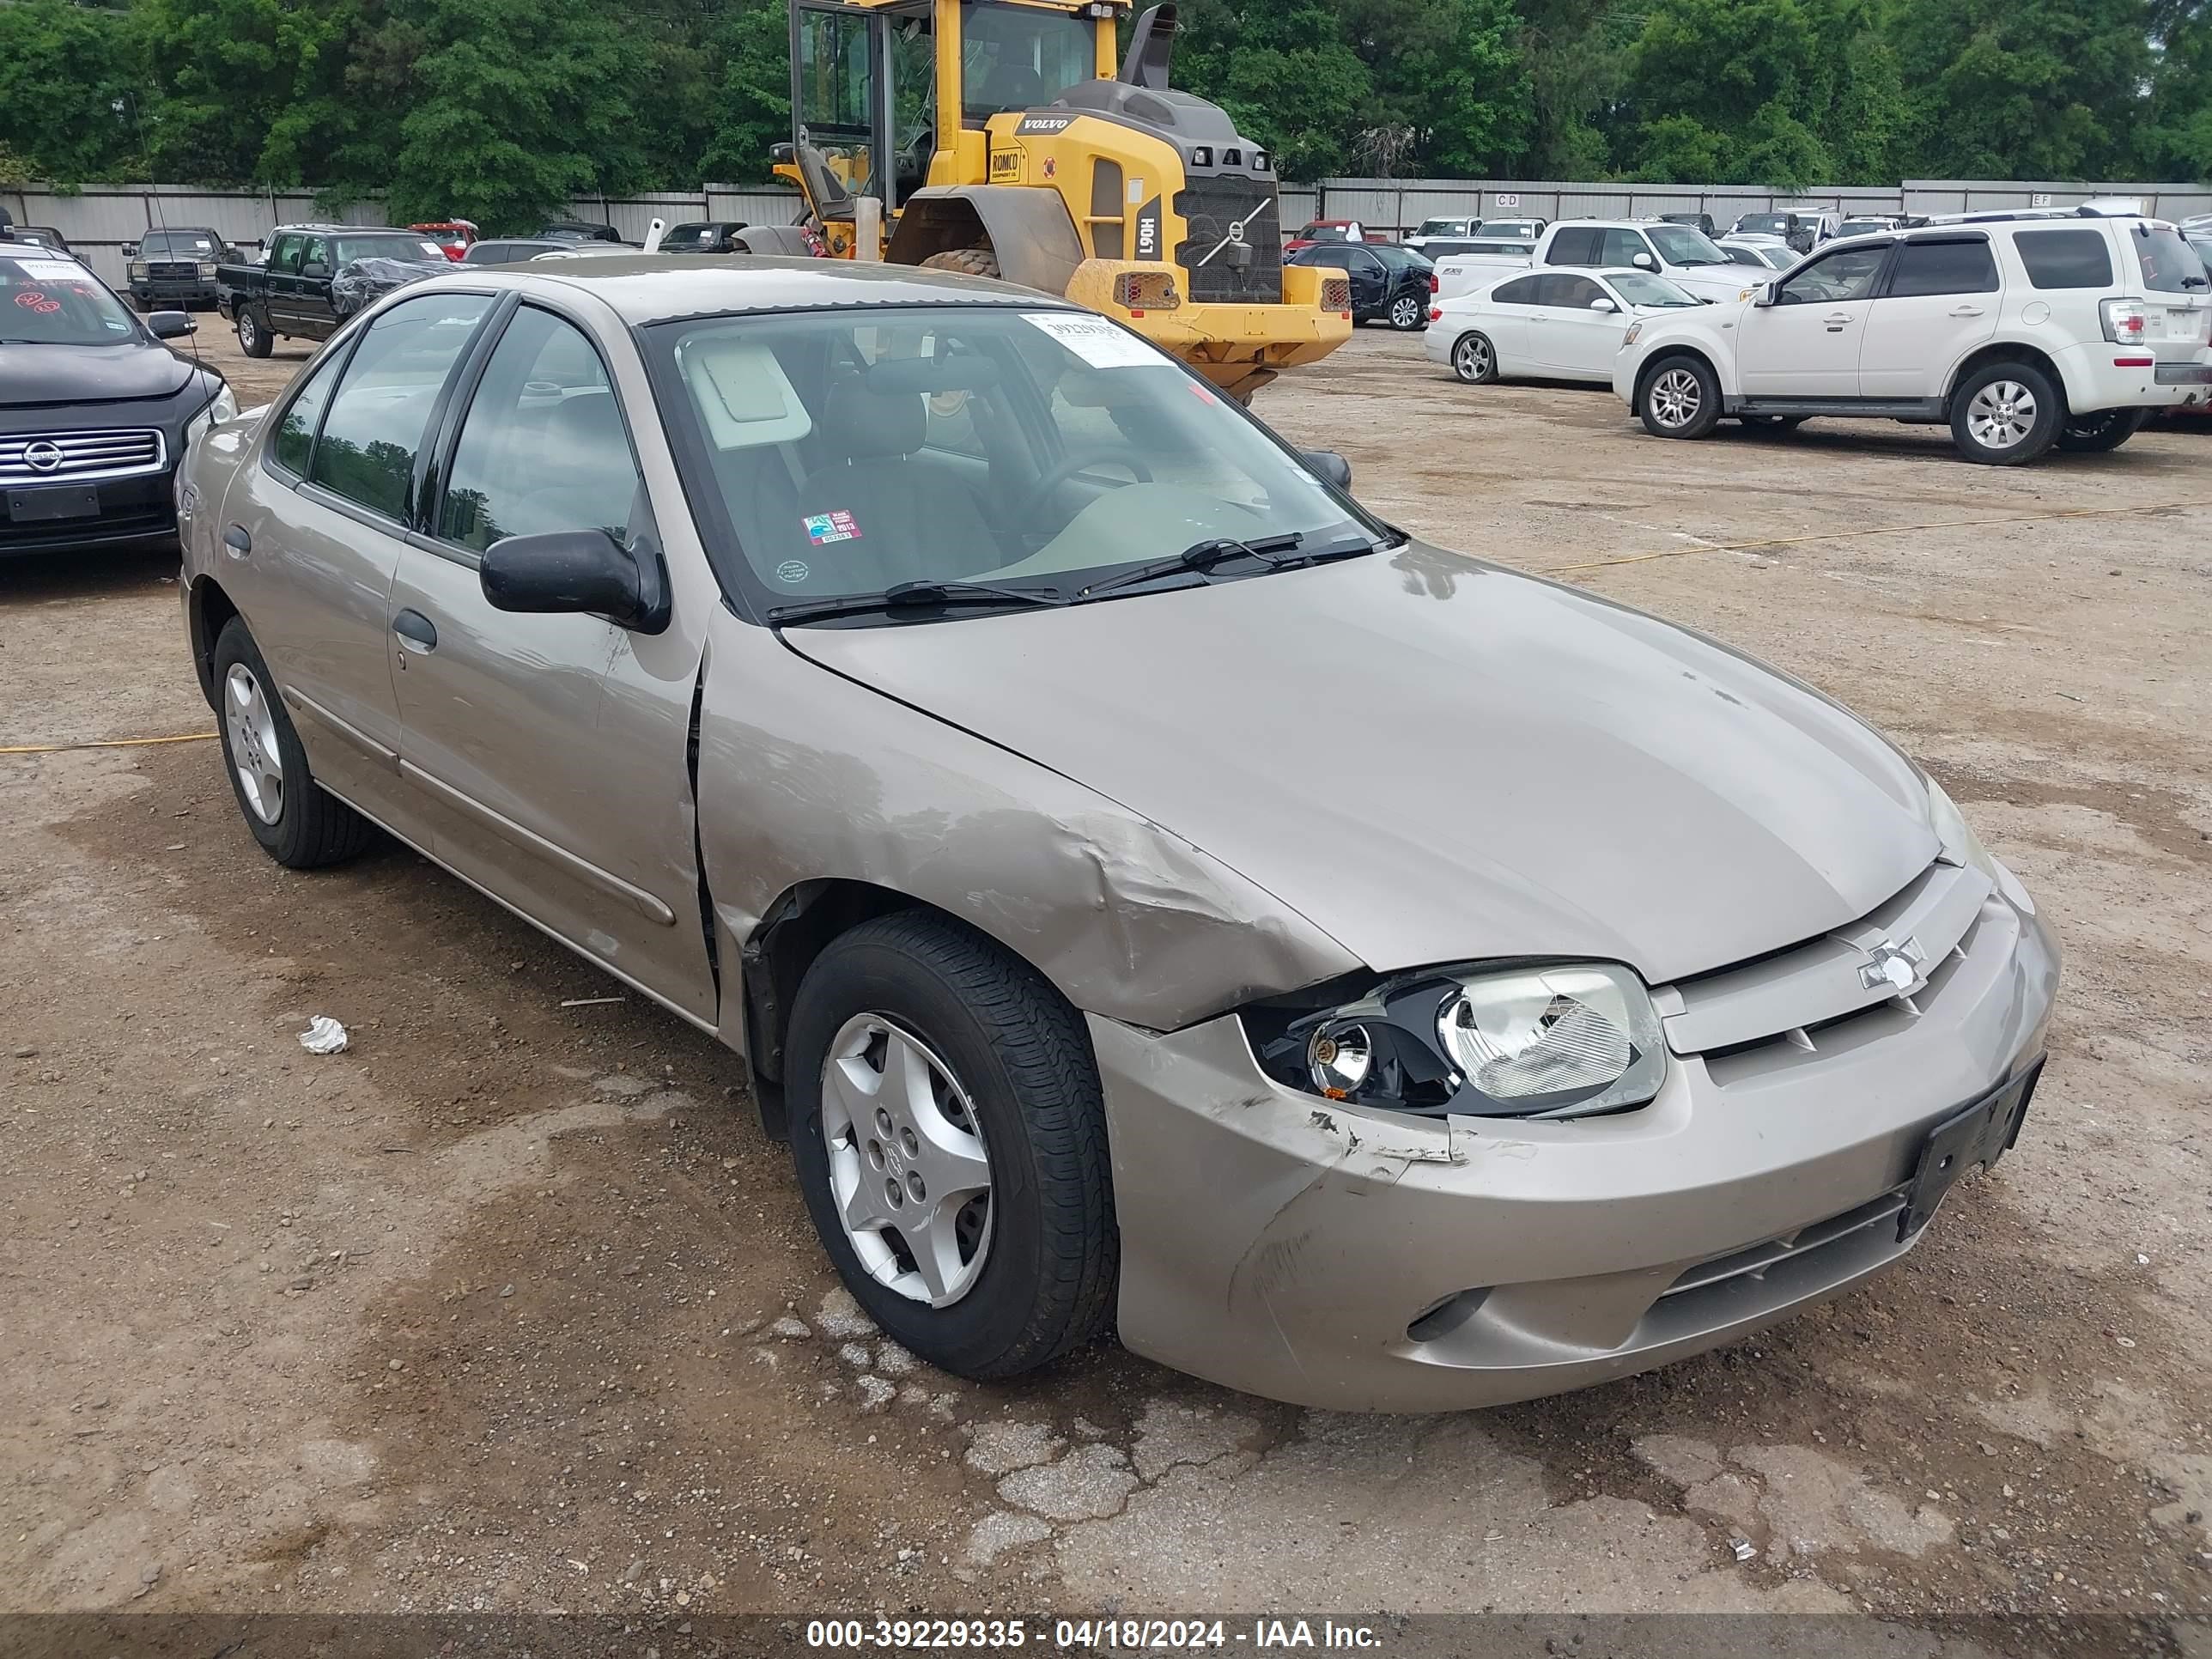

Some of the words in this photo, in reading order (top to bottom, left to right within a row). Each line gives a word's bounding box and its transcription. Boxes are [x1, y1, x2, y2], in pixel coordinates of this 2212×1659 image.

[1024, 119, 1068, 129] VOLVO
[993, 153, 1018, 172] ROMCO
[1139, 217, 1155, 253] L90H
[836, 522, 855, 532] 2013
